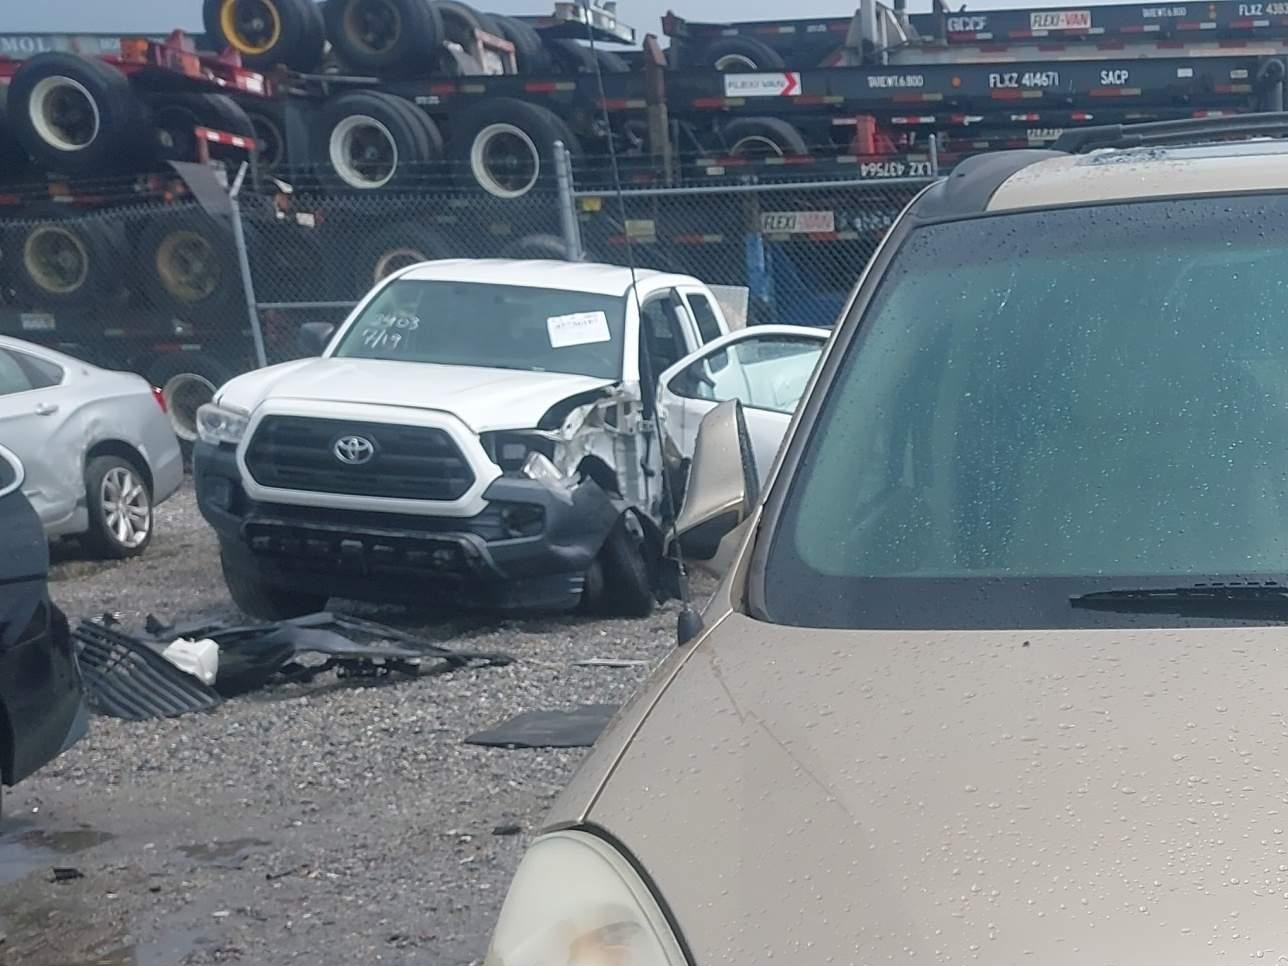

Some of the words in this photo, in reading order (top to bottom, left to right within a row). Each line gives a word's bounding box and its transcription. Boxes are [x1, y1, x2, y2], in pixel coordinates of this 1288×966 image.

[1032, 14, 1089, 28] FLEXI-VAN
[989, 74, 1018, 88] FLXZ
[1021, 72, 1059, 87] 414671
[1100, 70, 1129, 85] SACP
